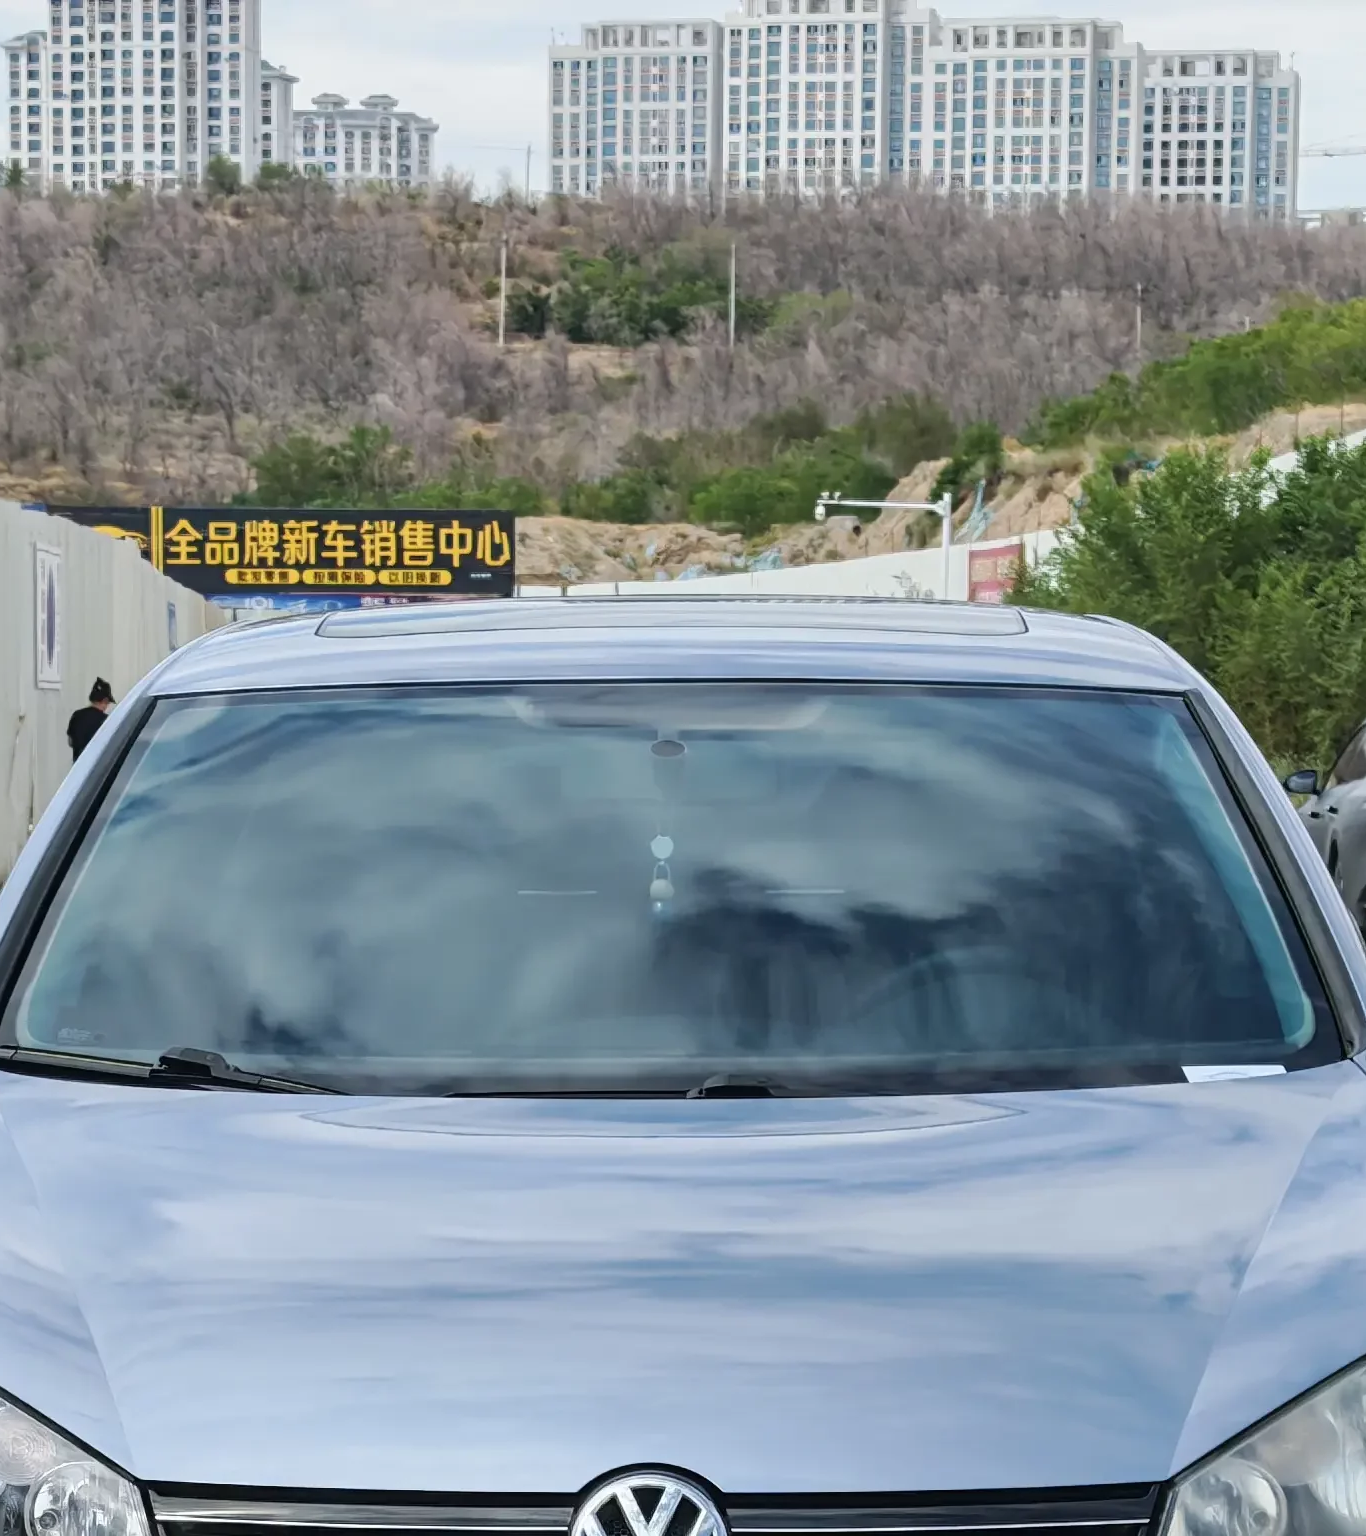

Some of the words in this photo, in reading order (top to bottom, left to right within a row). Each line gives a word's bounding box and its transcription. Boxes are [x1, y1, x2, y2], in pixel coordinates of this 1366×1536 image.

[164, 518, 511, 568] 全品牌新车销售中心
